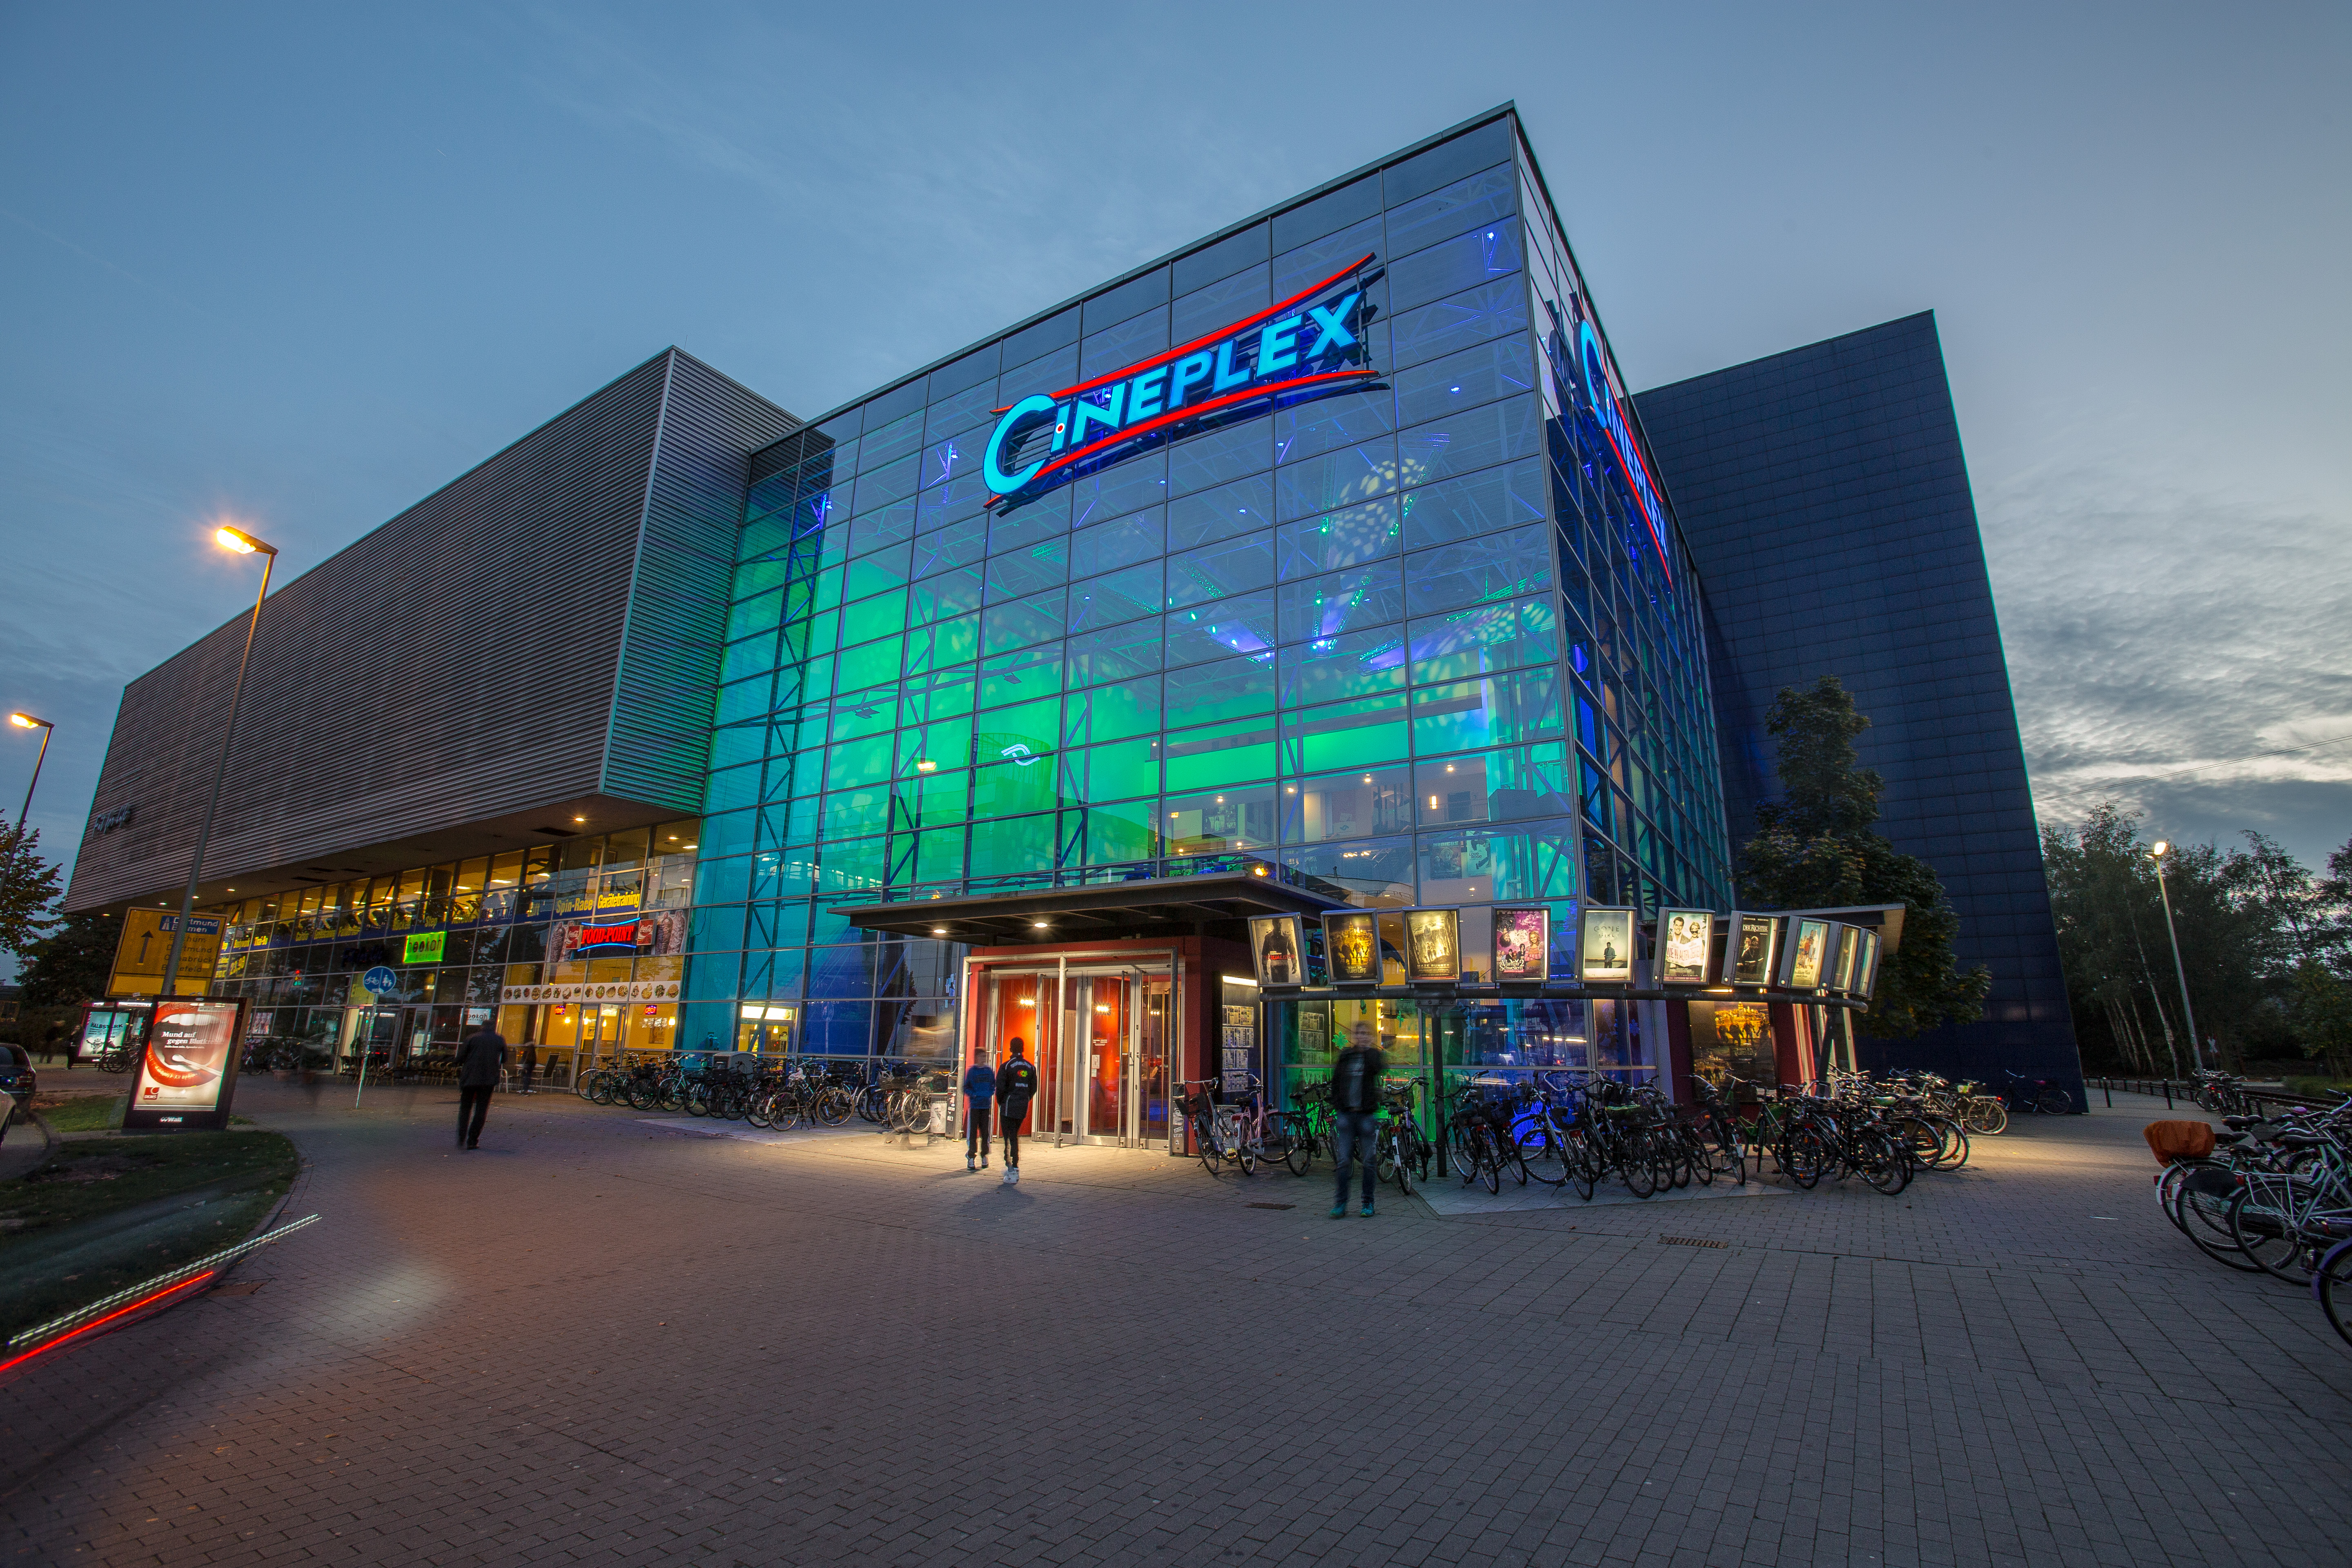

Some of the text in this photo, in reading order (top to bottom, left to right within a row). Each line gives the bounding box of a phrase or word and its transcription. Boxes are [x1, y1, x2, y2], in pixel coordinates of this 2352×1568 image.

[597, 891, 640, 909] Gerätetraining
[556, 898, 593, 915] Spin-Race
[174, 917, 218, 927] Dtmund
[172, 924, 207, 933] Bmen
[169, 934, 206, 942] Bhum
[581, 926, 635, 944] FOOD-POINT
[407, 934, 442, 953] hookah
[166, 944, 212, 953] Dtmund
[164, 954, 213, 963] Oabrück
[161, 964, 202, 972] Befeld
